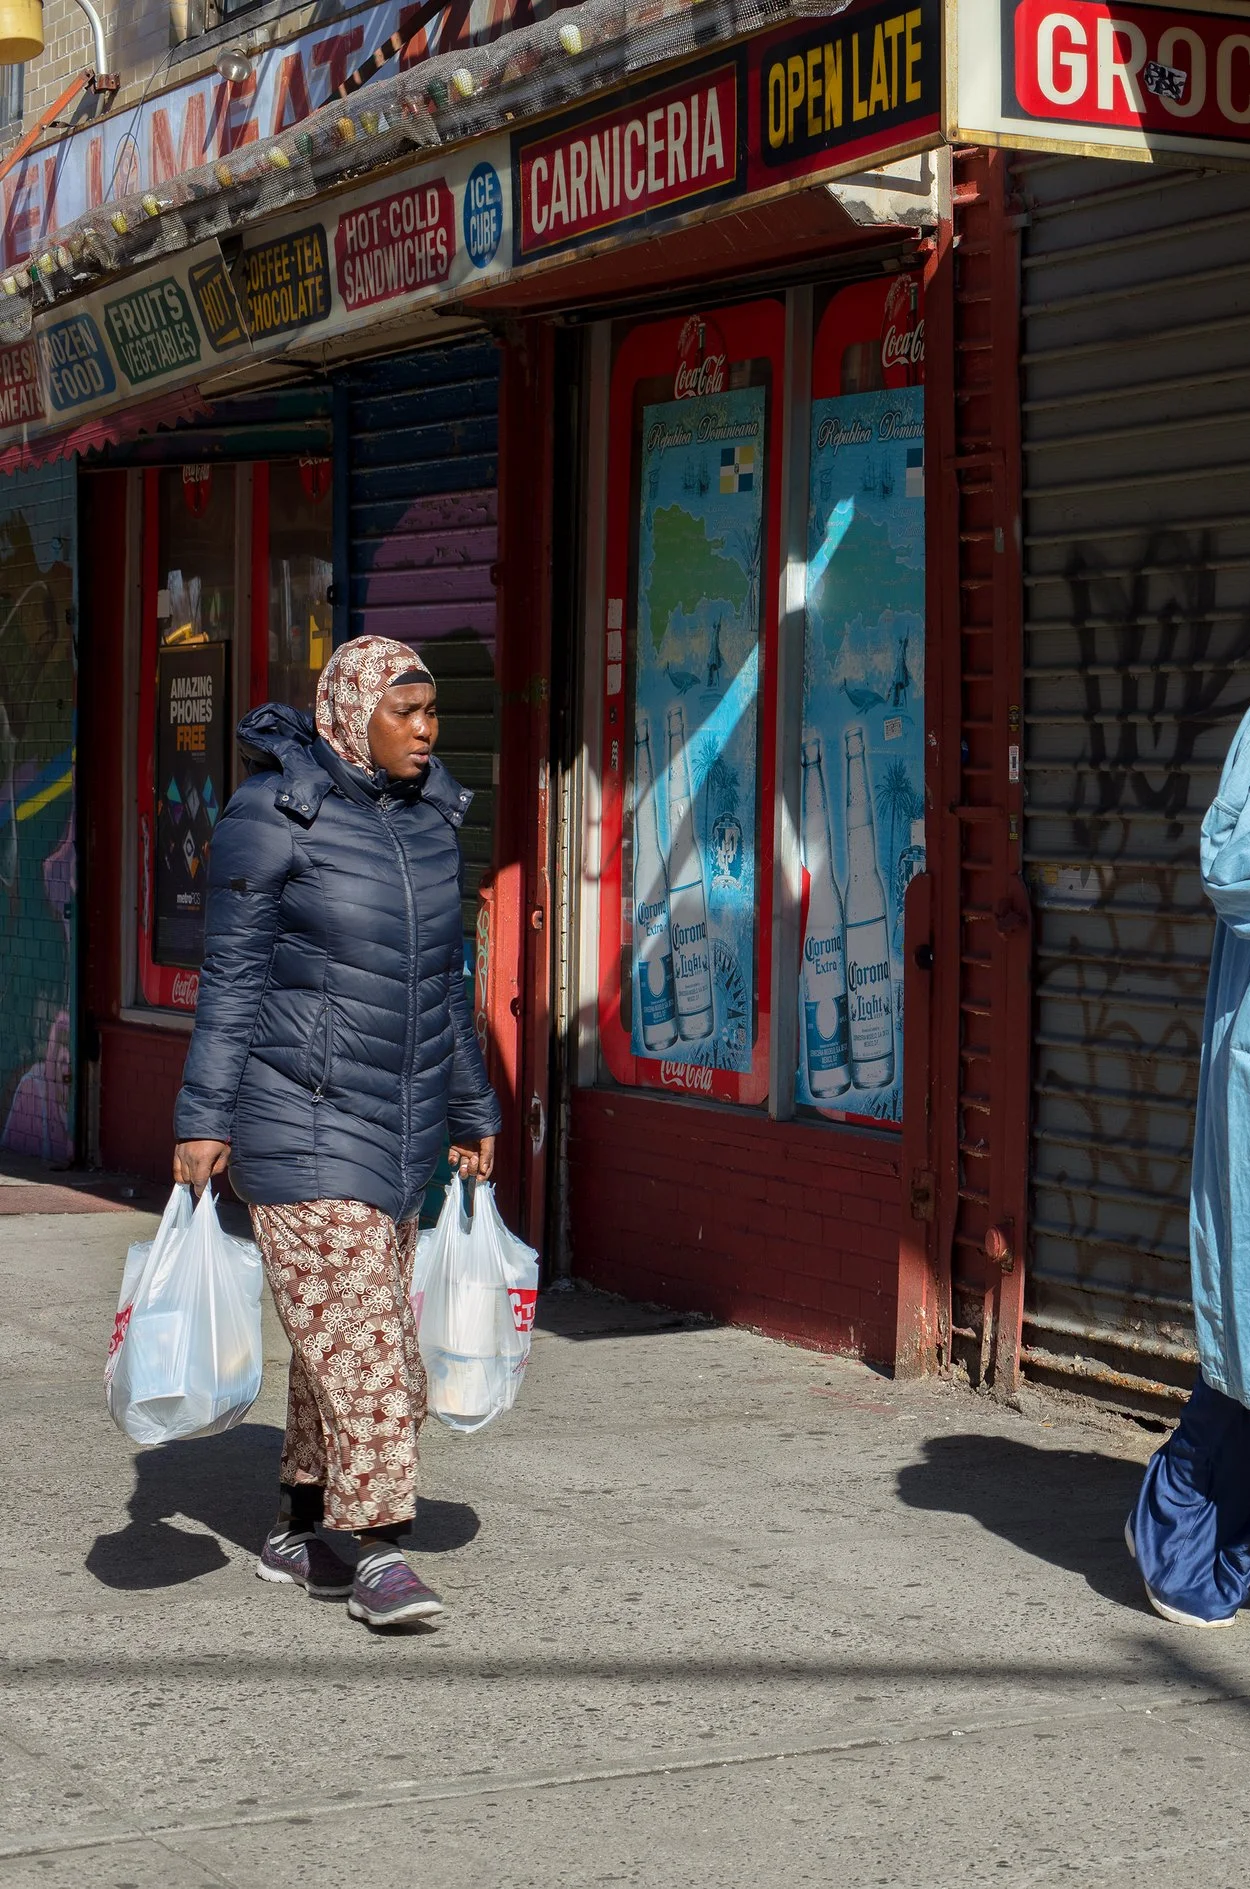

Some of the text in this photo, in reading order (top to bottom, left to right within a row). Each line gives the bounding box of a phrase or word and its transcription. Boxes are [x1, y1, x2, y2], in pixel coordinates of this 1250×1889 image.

[767, 8, 922, 149] OPEN LATE
[530, 86, 725, 235] CARNICERIA
[470, 172, 493, 211] ICE
[469, 208, 497, 257] CUBE
[343, 227, 448, 305] SANDWICHES
[107, 282, 184, 343] FRUITS
[199, 271, 232, 334] HOT
[121, 321, 198, 379] VEGETABLES
[51, 357, 105, 405] FOOD
[696, 415, 759, 444] Dominicana
[170, 675, 213, 699] AMAZING
[170, 698, 213, 724] PHONES
[176, 724, 207, 752] FREE
[637, 900, 667, 926] Corona
[646, 923, 664, 938] Extra
[671, 922, 707, 952] Corona
[804, 935, 842, 962] Corona
[679, 953, 703, 978] Light
[815, 959, 838, 976] Extra
[848, 961, 890, 992] Corona
[856, 995, 884, 1021] Light
